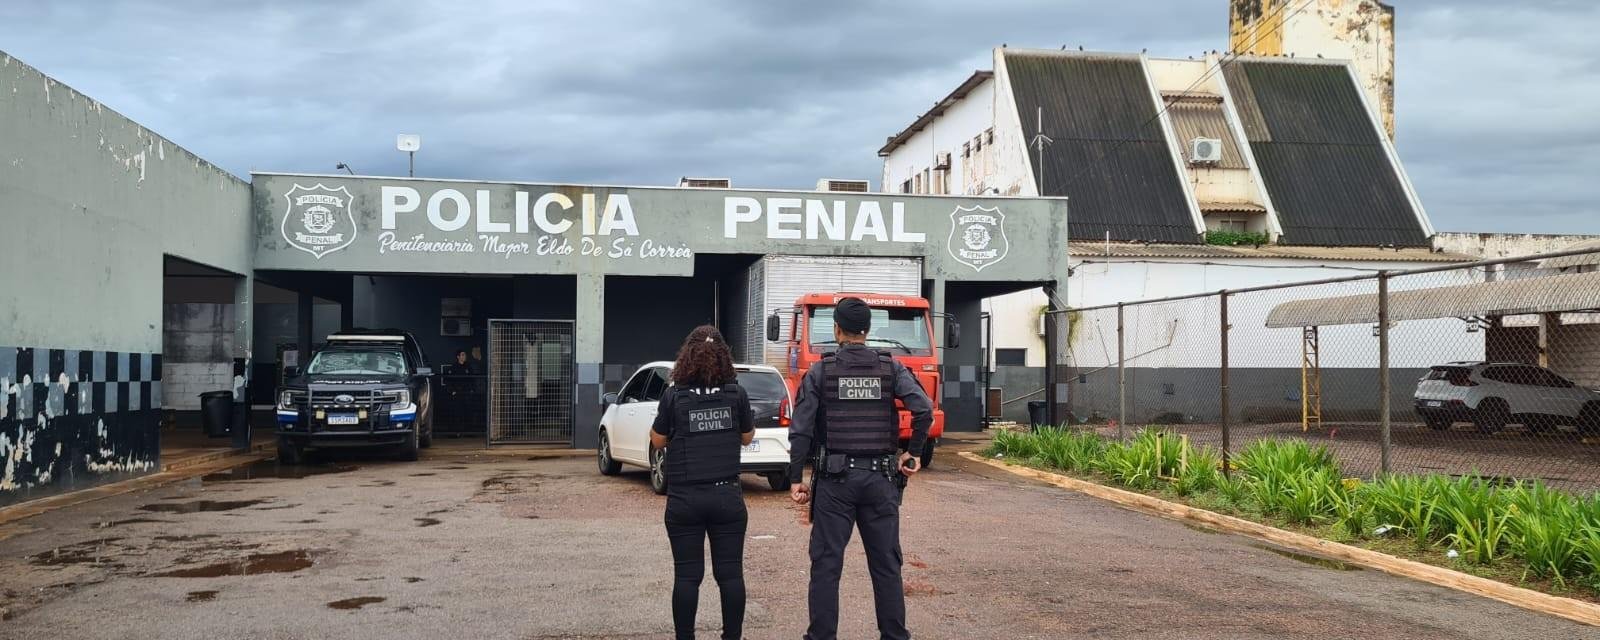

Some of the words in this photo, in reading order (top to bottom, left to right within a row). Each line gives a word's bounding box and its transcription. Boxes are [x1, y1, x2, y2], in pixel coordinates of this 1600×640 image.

[381, 186, 640, 236] POLICIA
[724, 196, 926, 243] PENAL
[536, 235, 574, 256] Eldo
[581, 237, 603, 256] De
[847, 389, 875, 398] CIVIL
[698, 421, 724, 431] CIVIL
